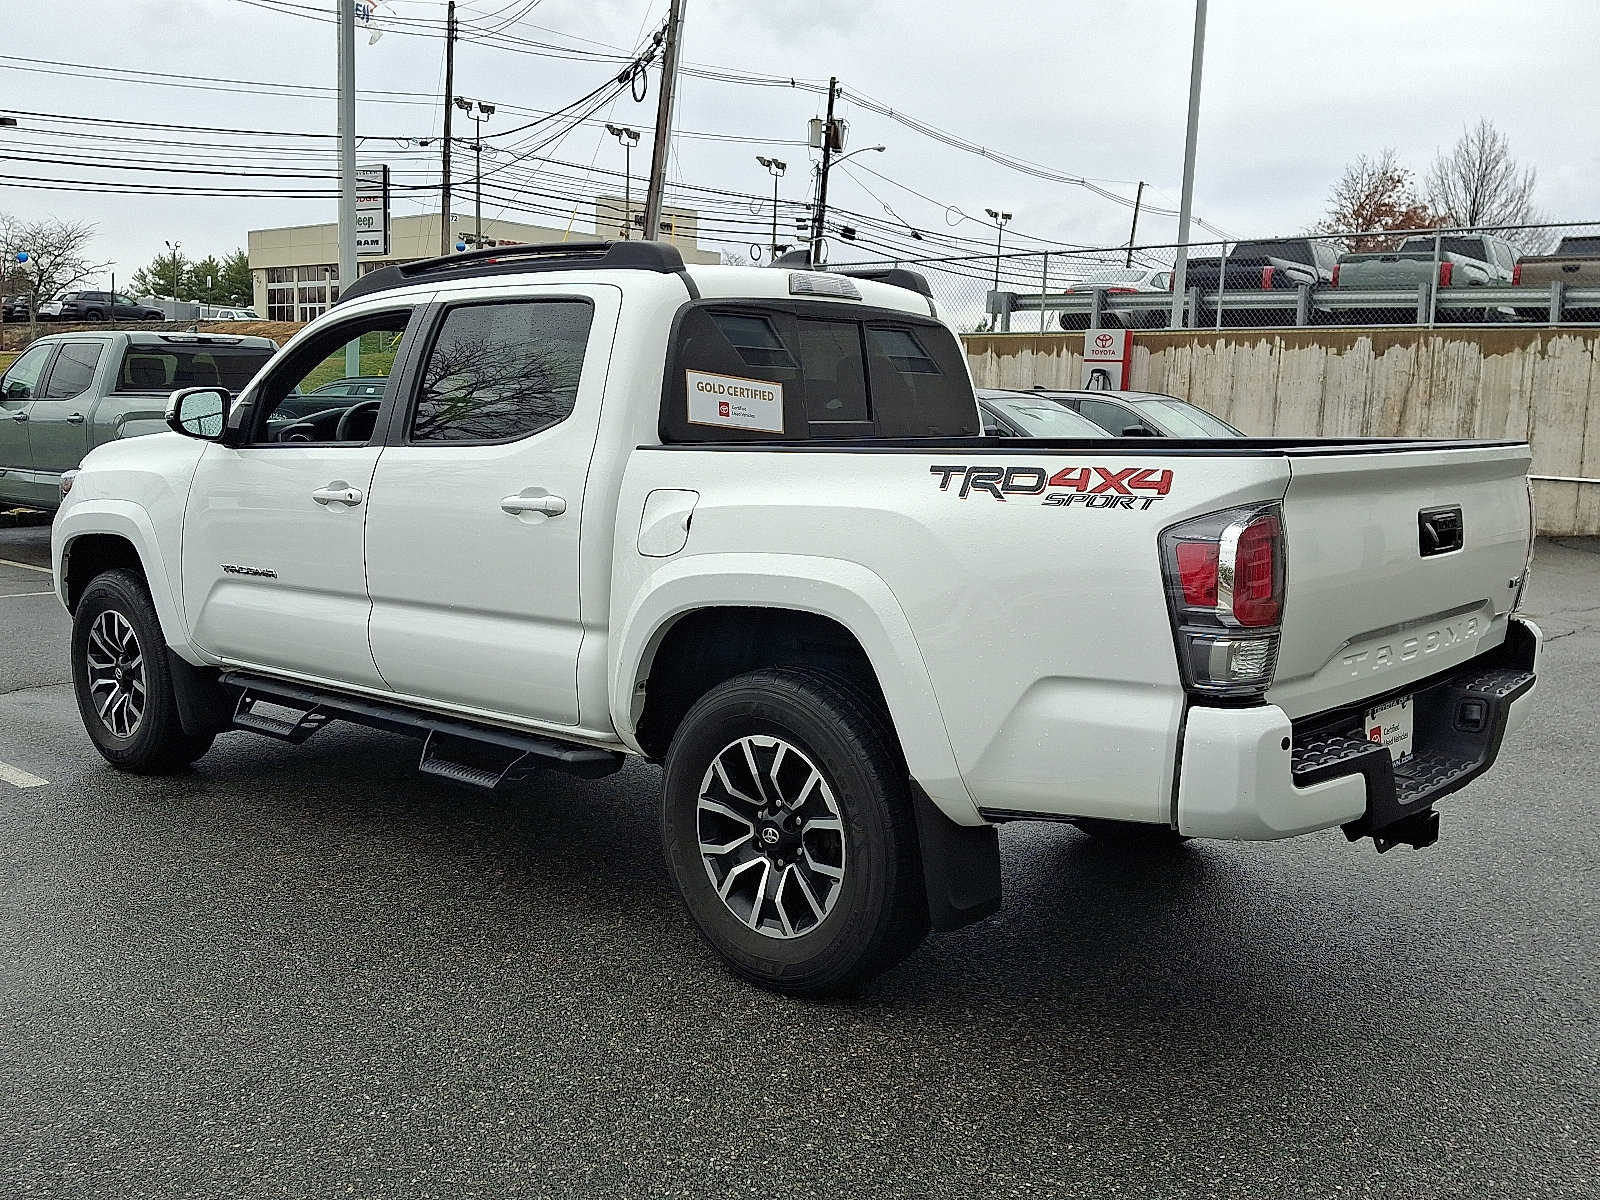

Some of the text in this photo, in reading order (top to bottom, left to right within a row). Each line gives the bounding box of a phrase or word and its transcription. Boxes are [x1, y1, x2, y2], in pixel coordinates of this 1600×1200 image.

[356, 239, 380, 247] RAM
[696, 381, 774, 401] GOLD CERTIFIED
[731, 404, 747, 412] Certified
[930, 465, 1174, 502] TRD 4X4
[1041, 493, 1165, 510] SPORT
[220, 563, 278, 579] TACOMA
[1343, 617, 1479, 677] TACOMA
[1383, 723, 1400, 736] Certified
[1394, 731, 1409, 744] Vehicles
